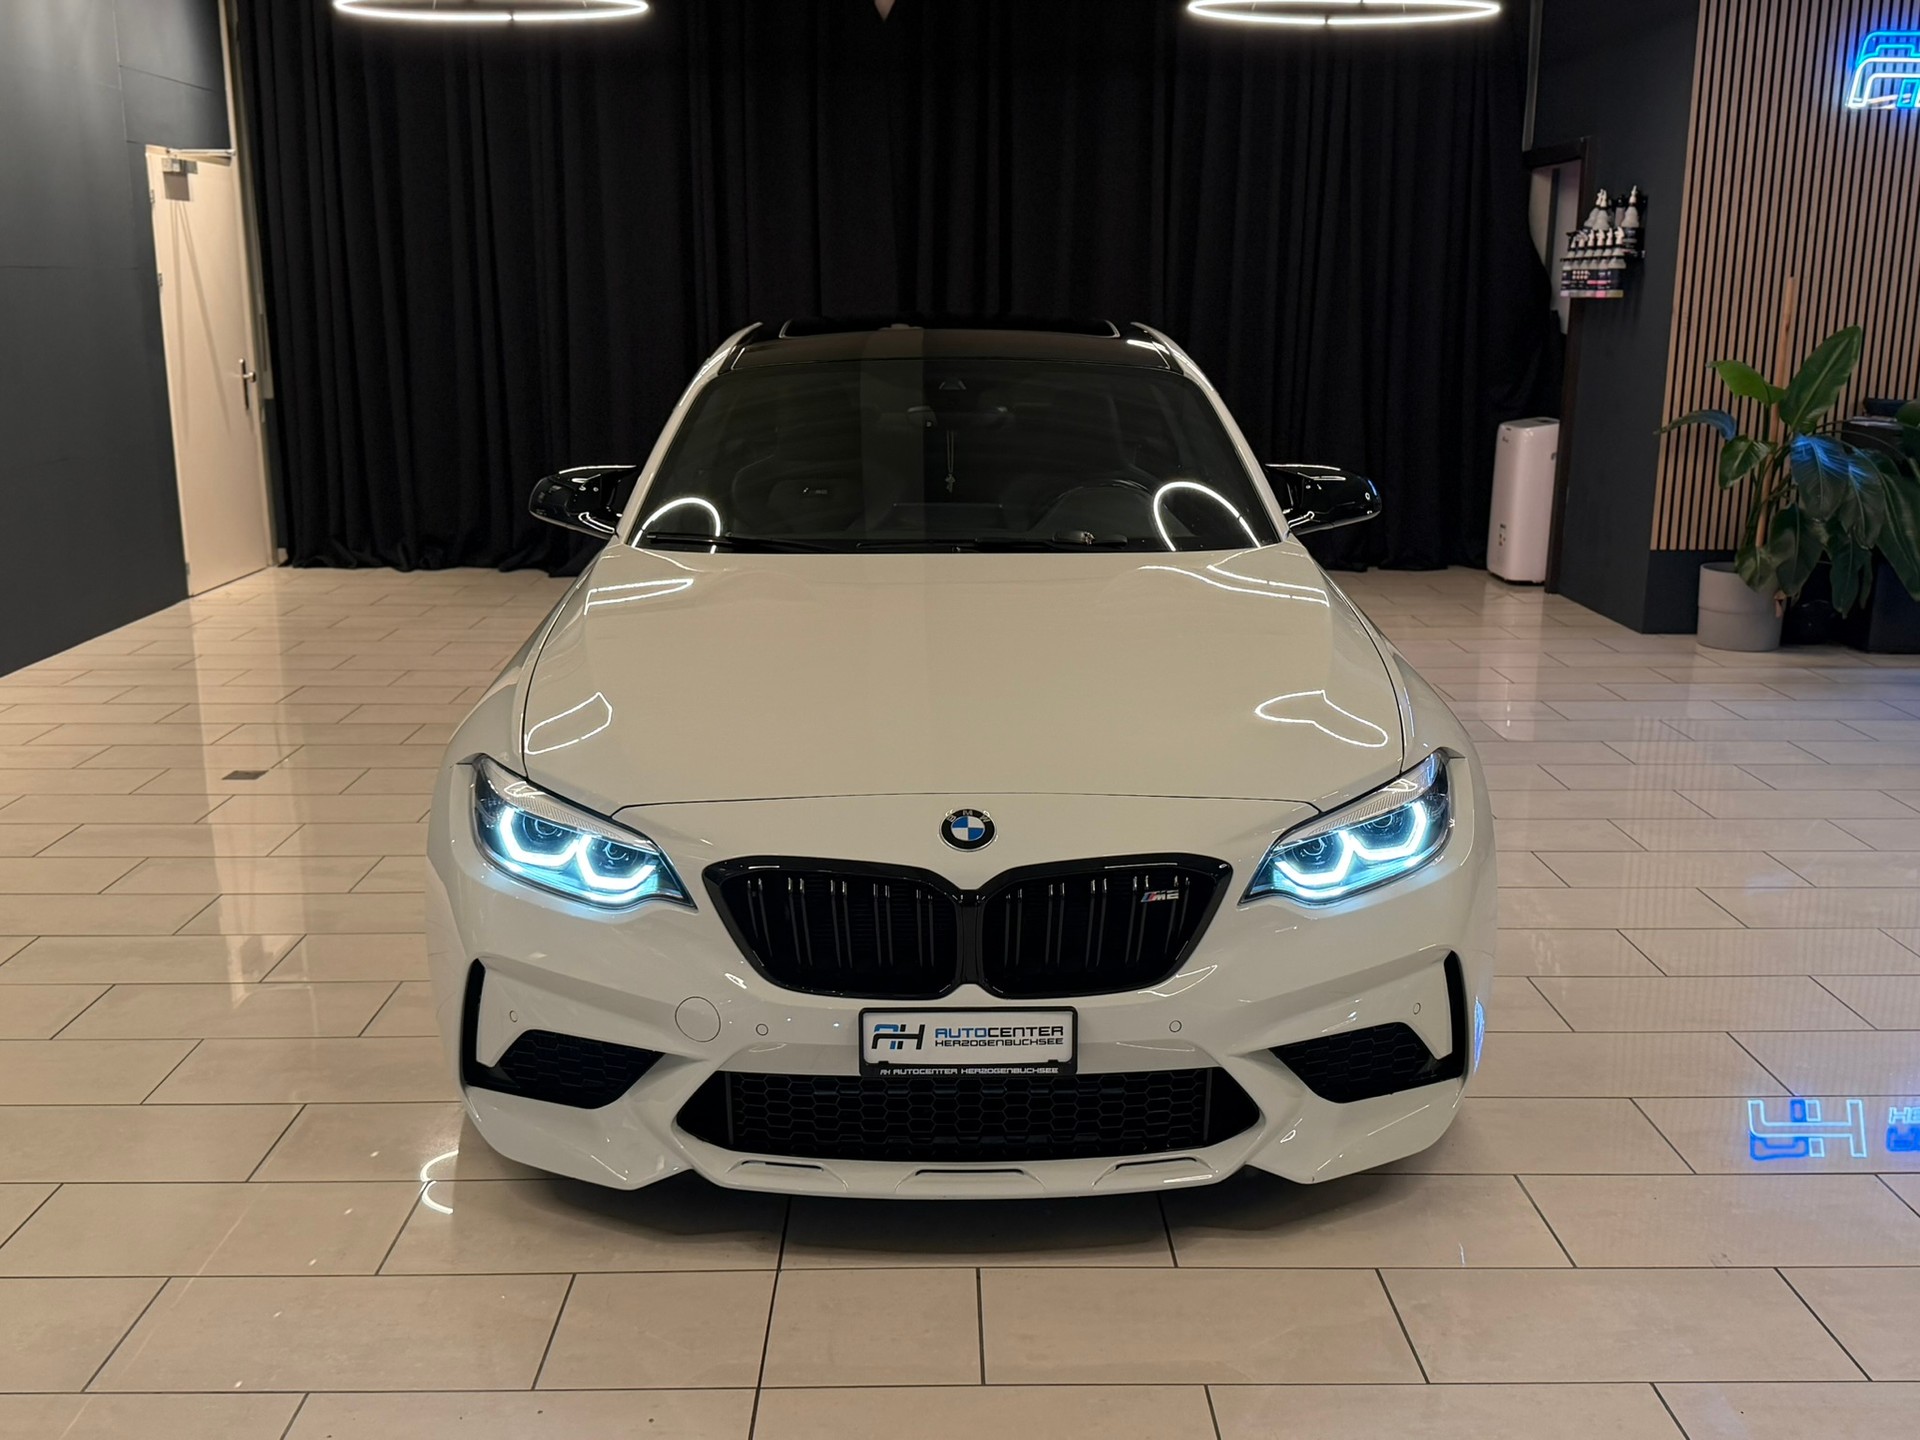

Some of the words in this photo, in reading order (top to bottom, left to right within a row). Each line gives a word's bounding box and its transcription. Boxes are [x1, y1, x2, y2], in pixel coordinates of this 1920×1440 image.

[946, 810, 991, 823] BMW
[934, 1026, 1064, 1039] AUTOCENTER
[934, 1037, 1064, 1047] HERZOGENBUCHSEE
